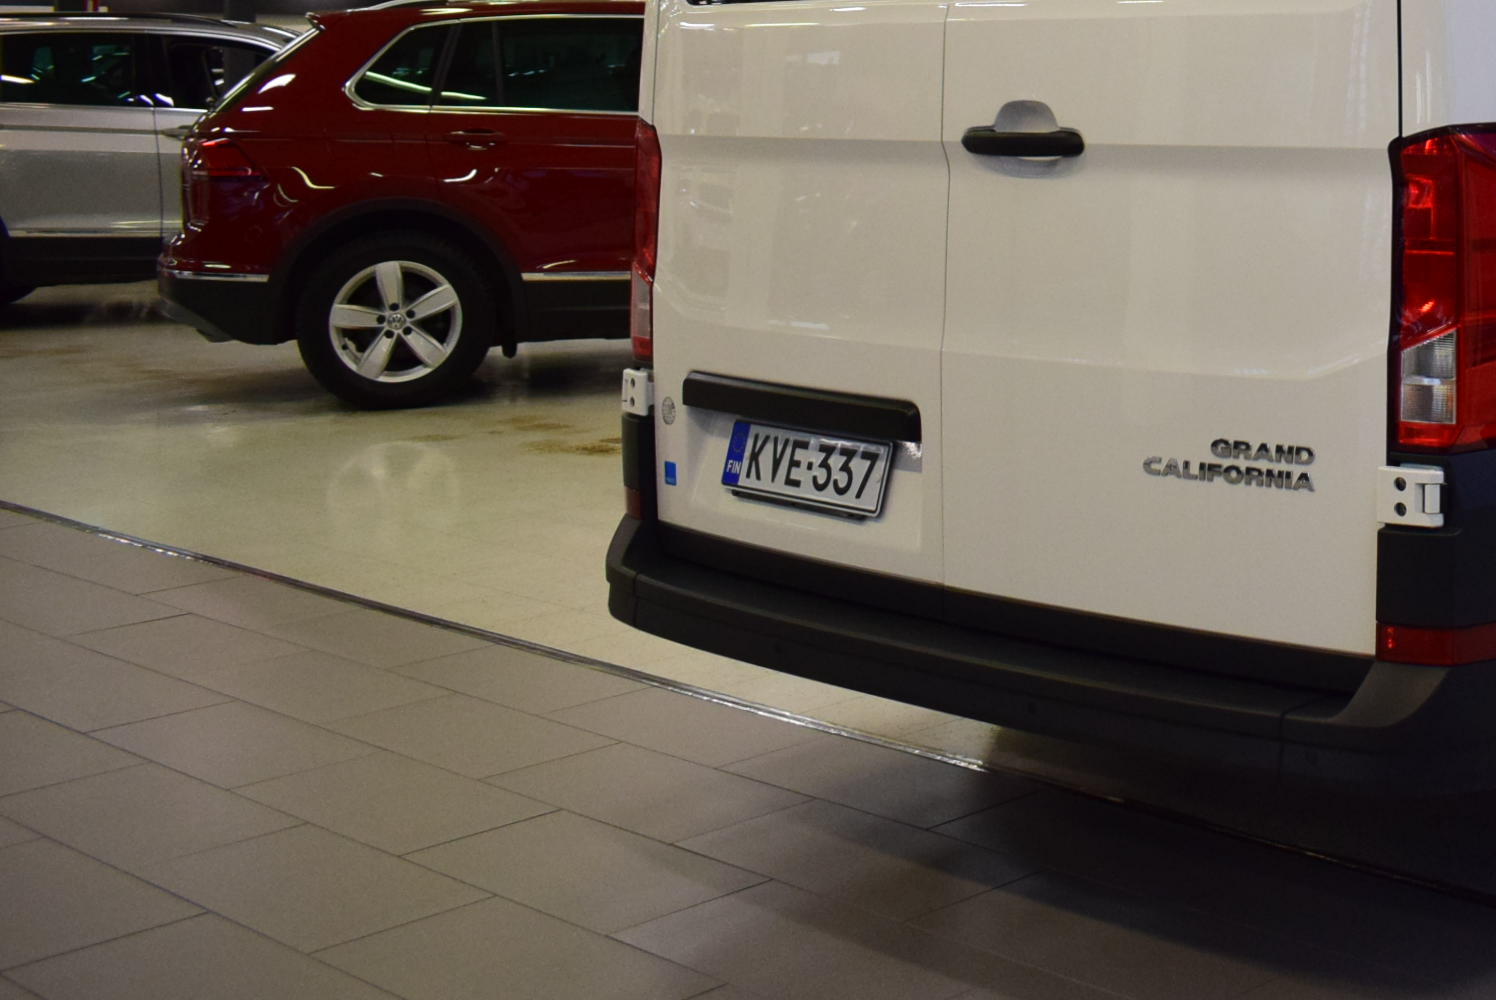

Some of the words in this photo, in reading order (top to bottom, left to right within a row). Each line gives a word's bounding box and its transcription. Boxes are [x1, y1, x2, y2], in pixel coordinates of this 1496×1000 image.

[726, 459, 742, 474] FIN
[746, 432, 880, 500] KVE-337
[1210, 438, 1315, 466] GRAND
[1142, 456, 1315, 492] CALIFORNIA
